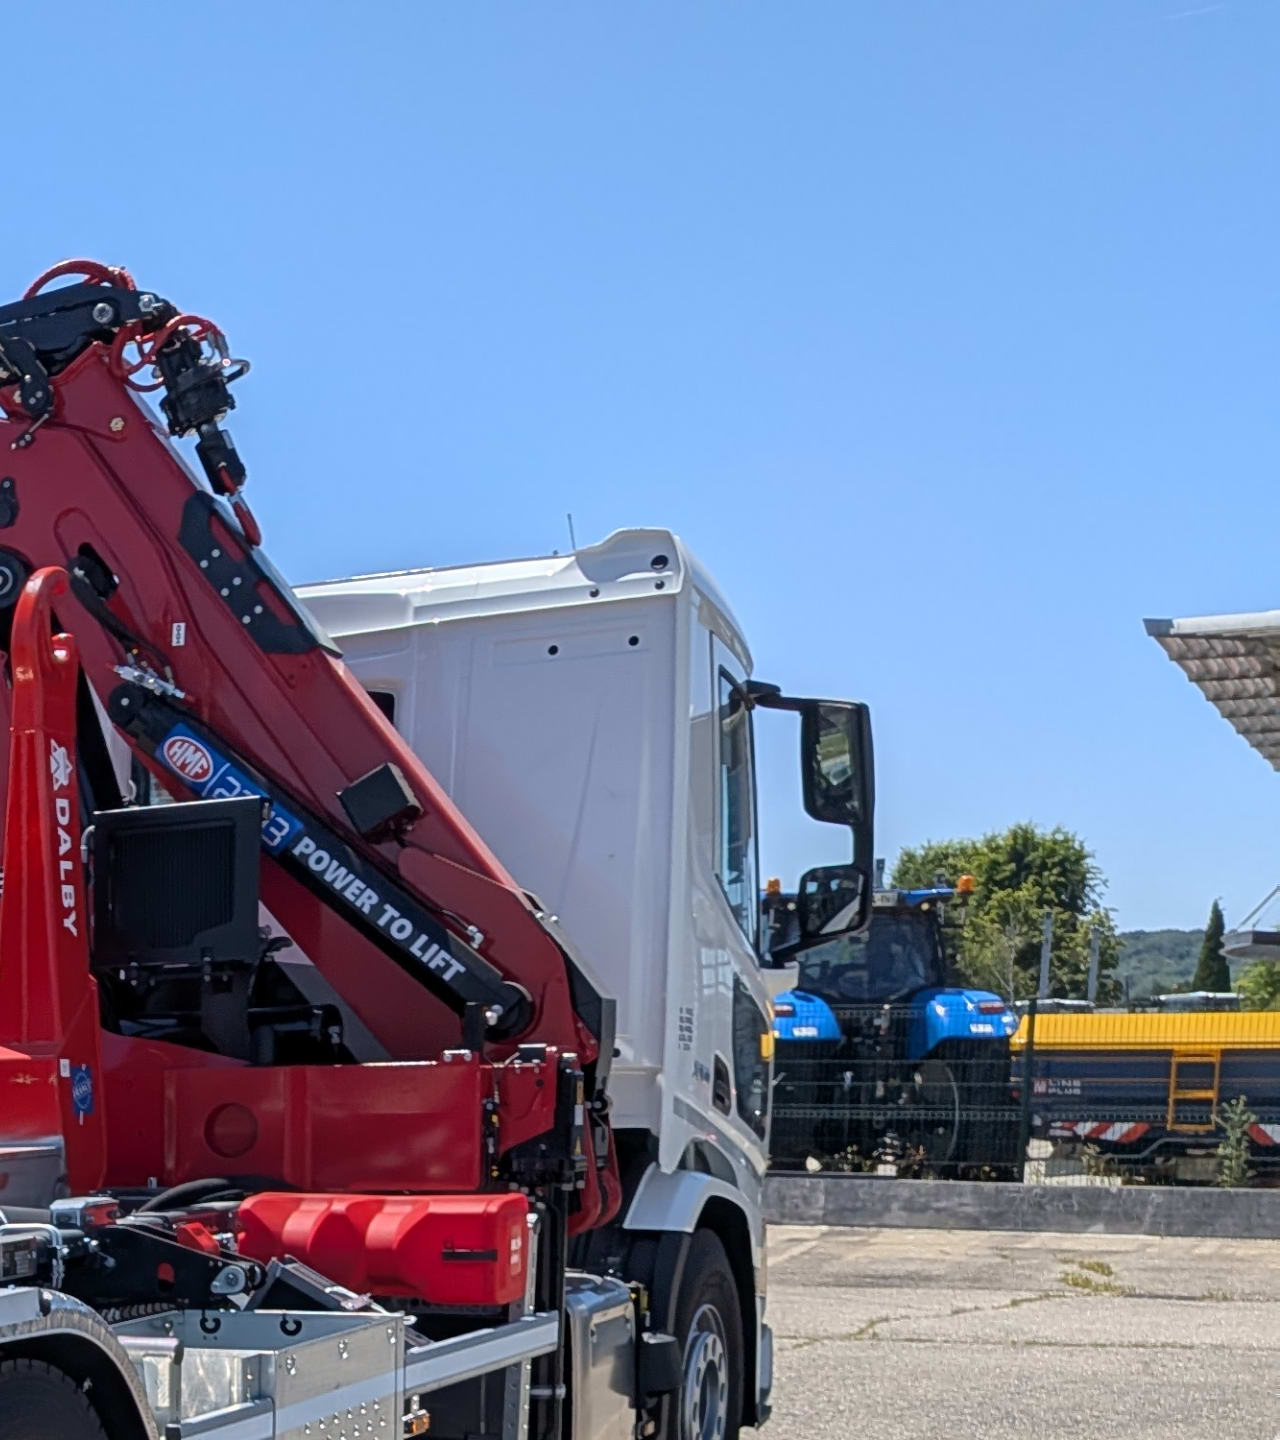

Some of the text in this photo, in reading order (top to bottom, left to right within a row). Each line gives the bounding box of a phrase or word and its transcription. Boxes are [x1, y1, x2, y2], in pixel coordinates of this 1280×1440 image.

[167, 740, 207, 777] HMF
[56, 798, 78, 937] DALBY
[292, 836, 466, 981] POWER TO LIFT
